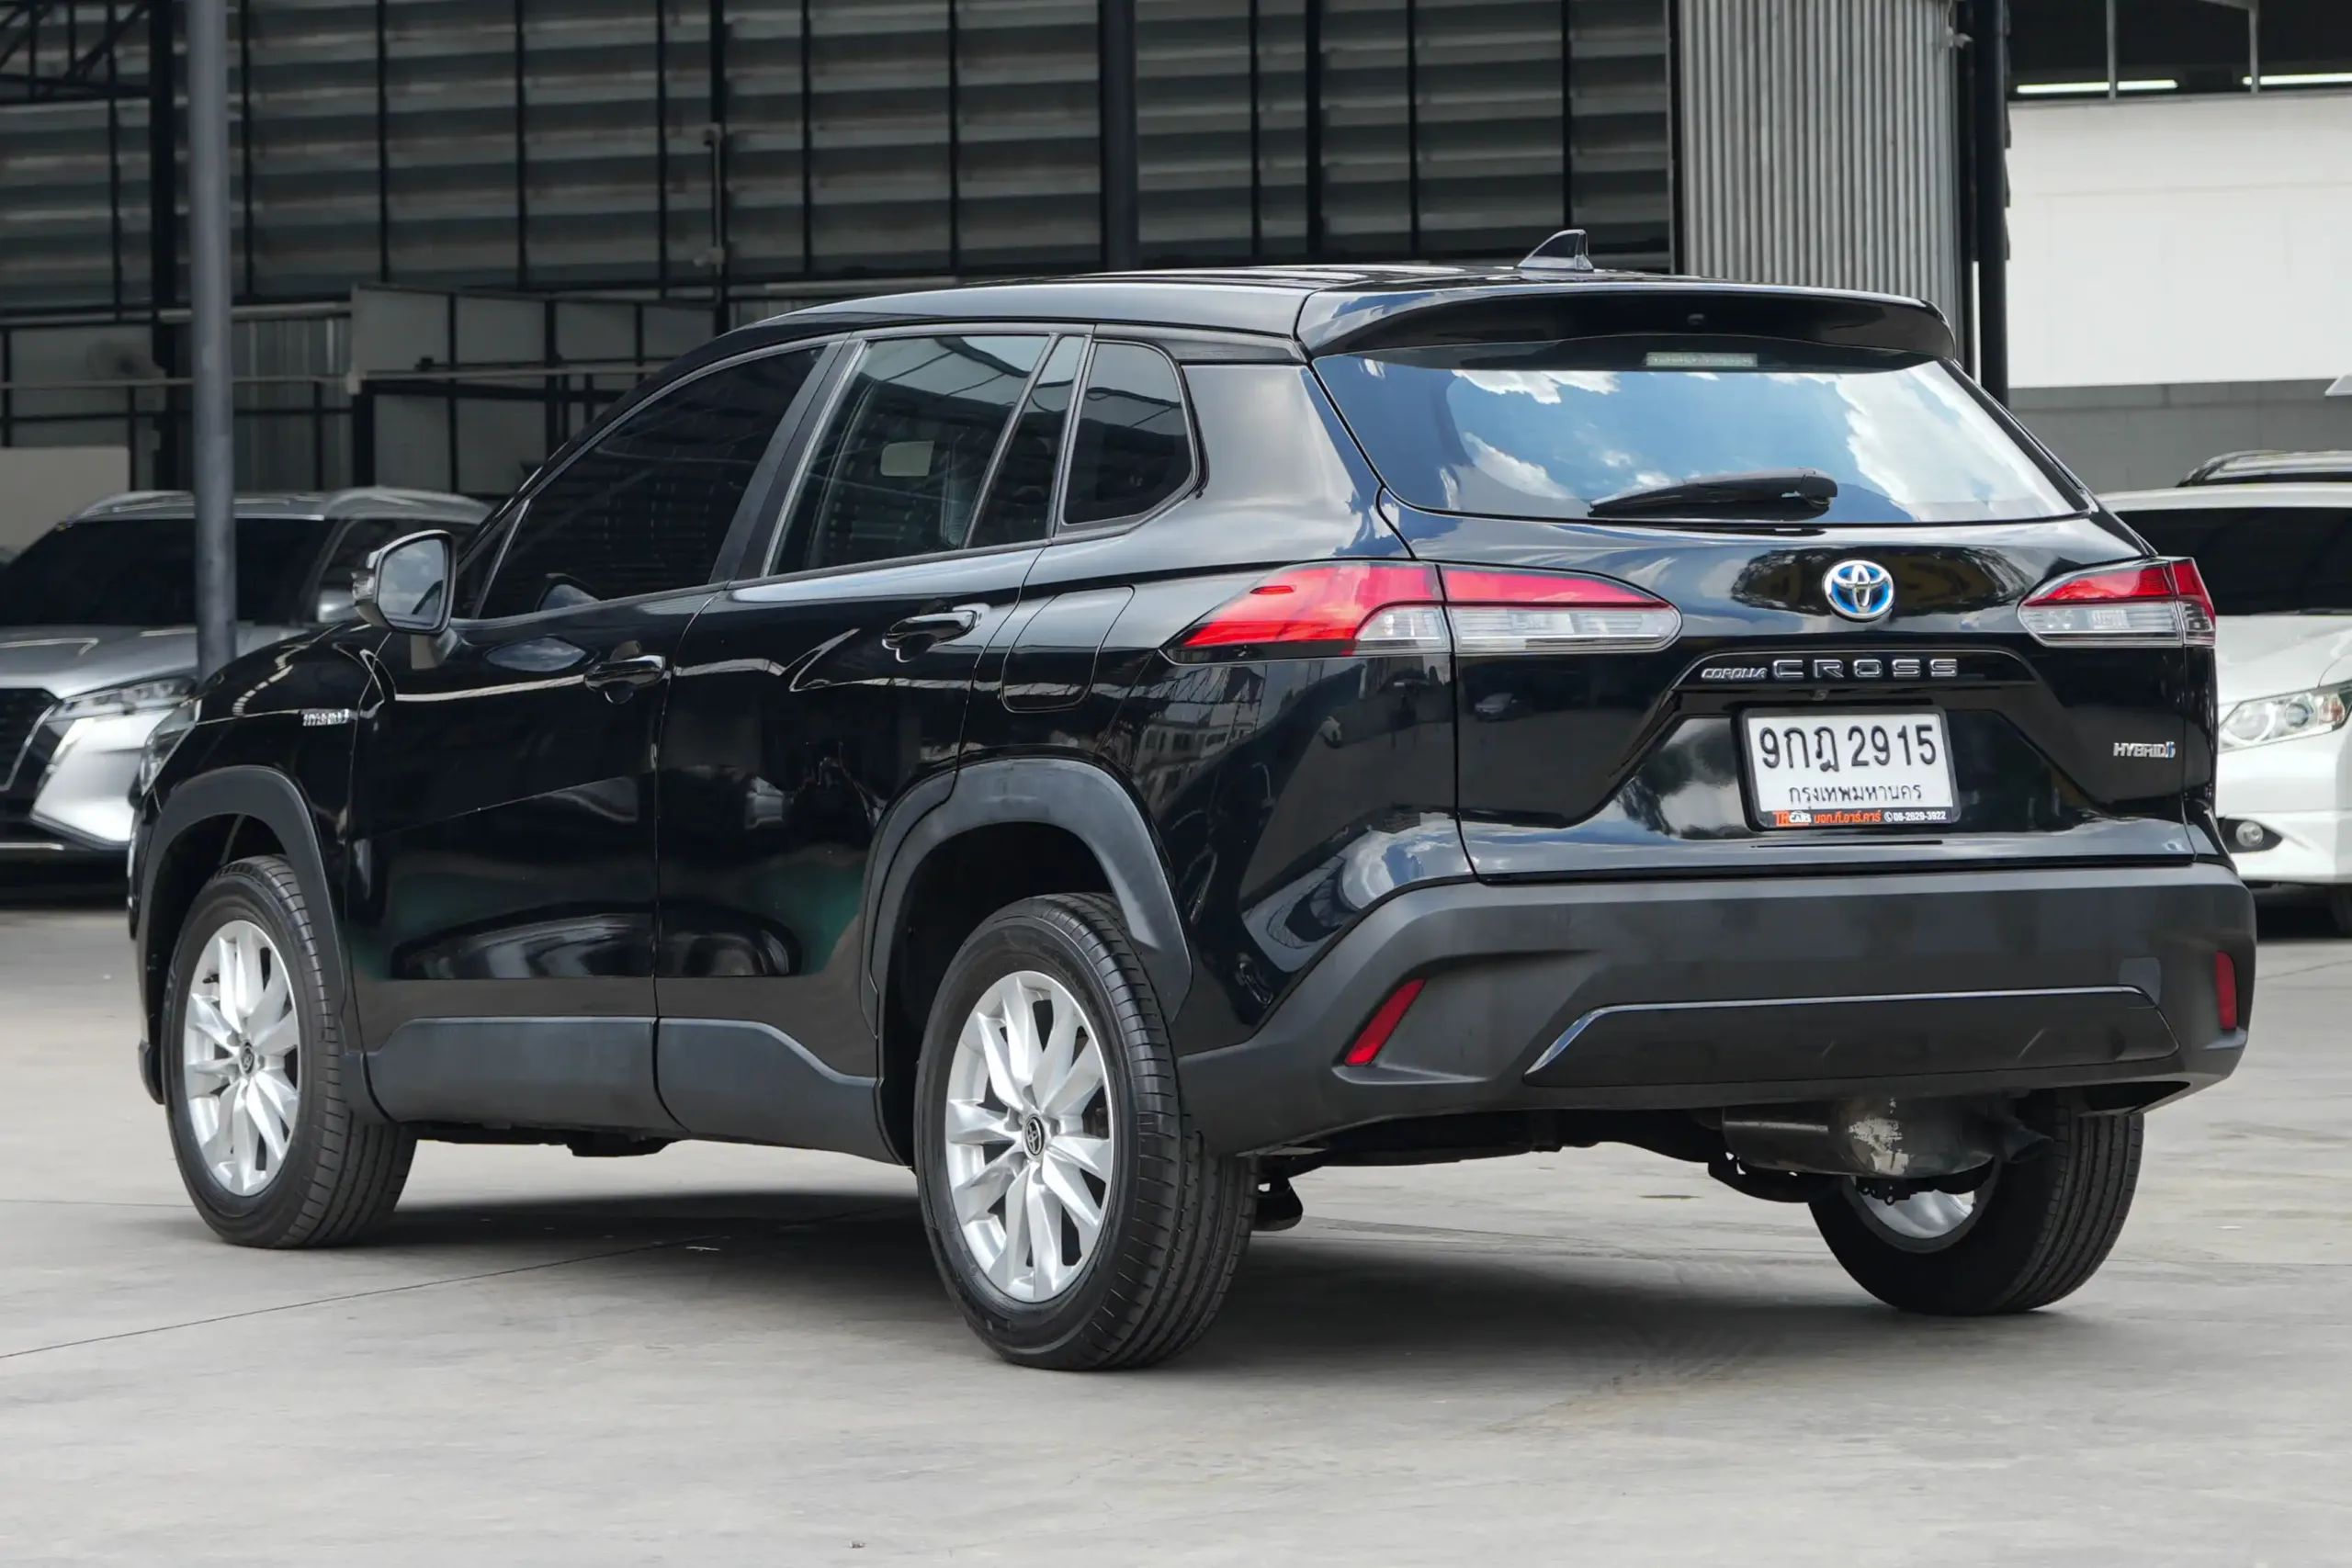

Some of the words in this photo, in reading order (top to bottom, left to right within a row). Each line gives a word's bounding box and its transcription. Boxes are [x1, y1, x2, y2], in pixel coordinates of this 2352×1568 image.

[1772, 659, 1959, 679] CROSS
[1759, 725, 1839, 773] 9กฎ
[1848, 724, 1938, 768] 2915
[1788, 784, 1922, 809] กรุงเทพมหานคร
